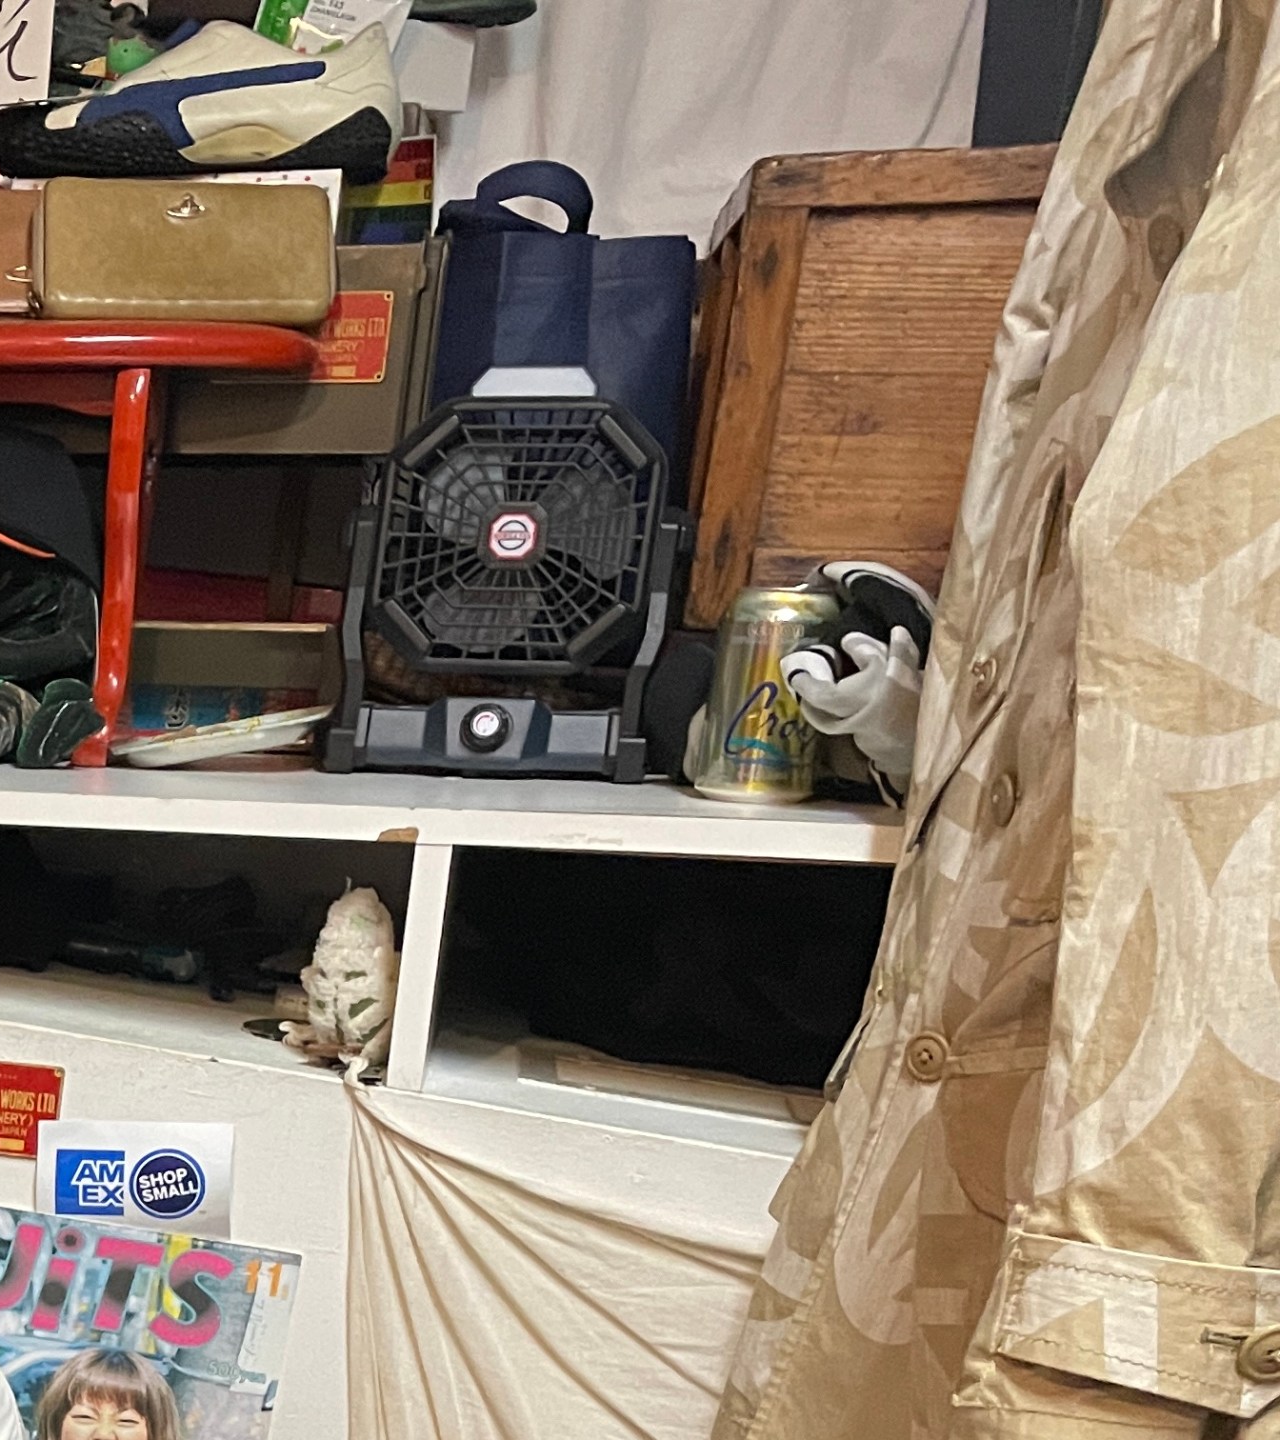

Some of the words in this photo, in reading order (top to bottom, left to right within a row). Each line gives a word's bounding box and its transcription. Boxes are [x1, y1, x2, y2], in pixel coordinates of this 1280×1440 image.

[0, 1086, 35, 1111] WORKS
[72, 1160, 125, 1185] AM
[138, 1167, 188, 1190] SHOP
[79, 1183, 125, 1207] EX
[141, 1180, 199, 1203] SMALL
